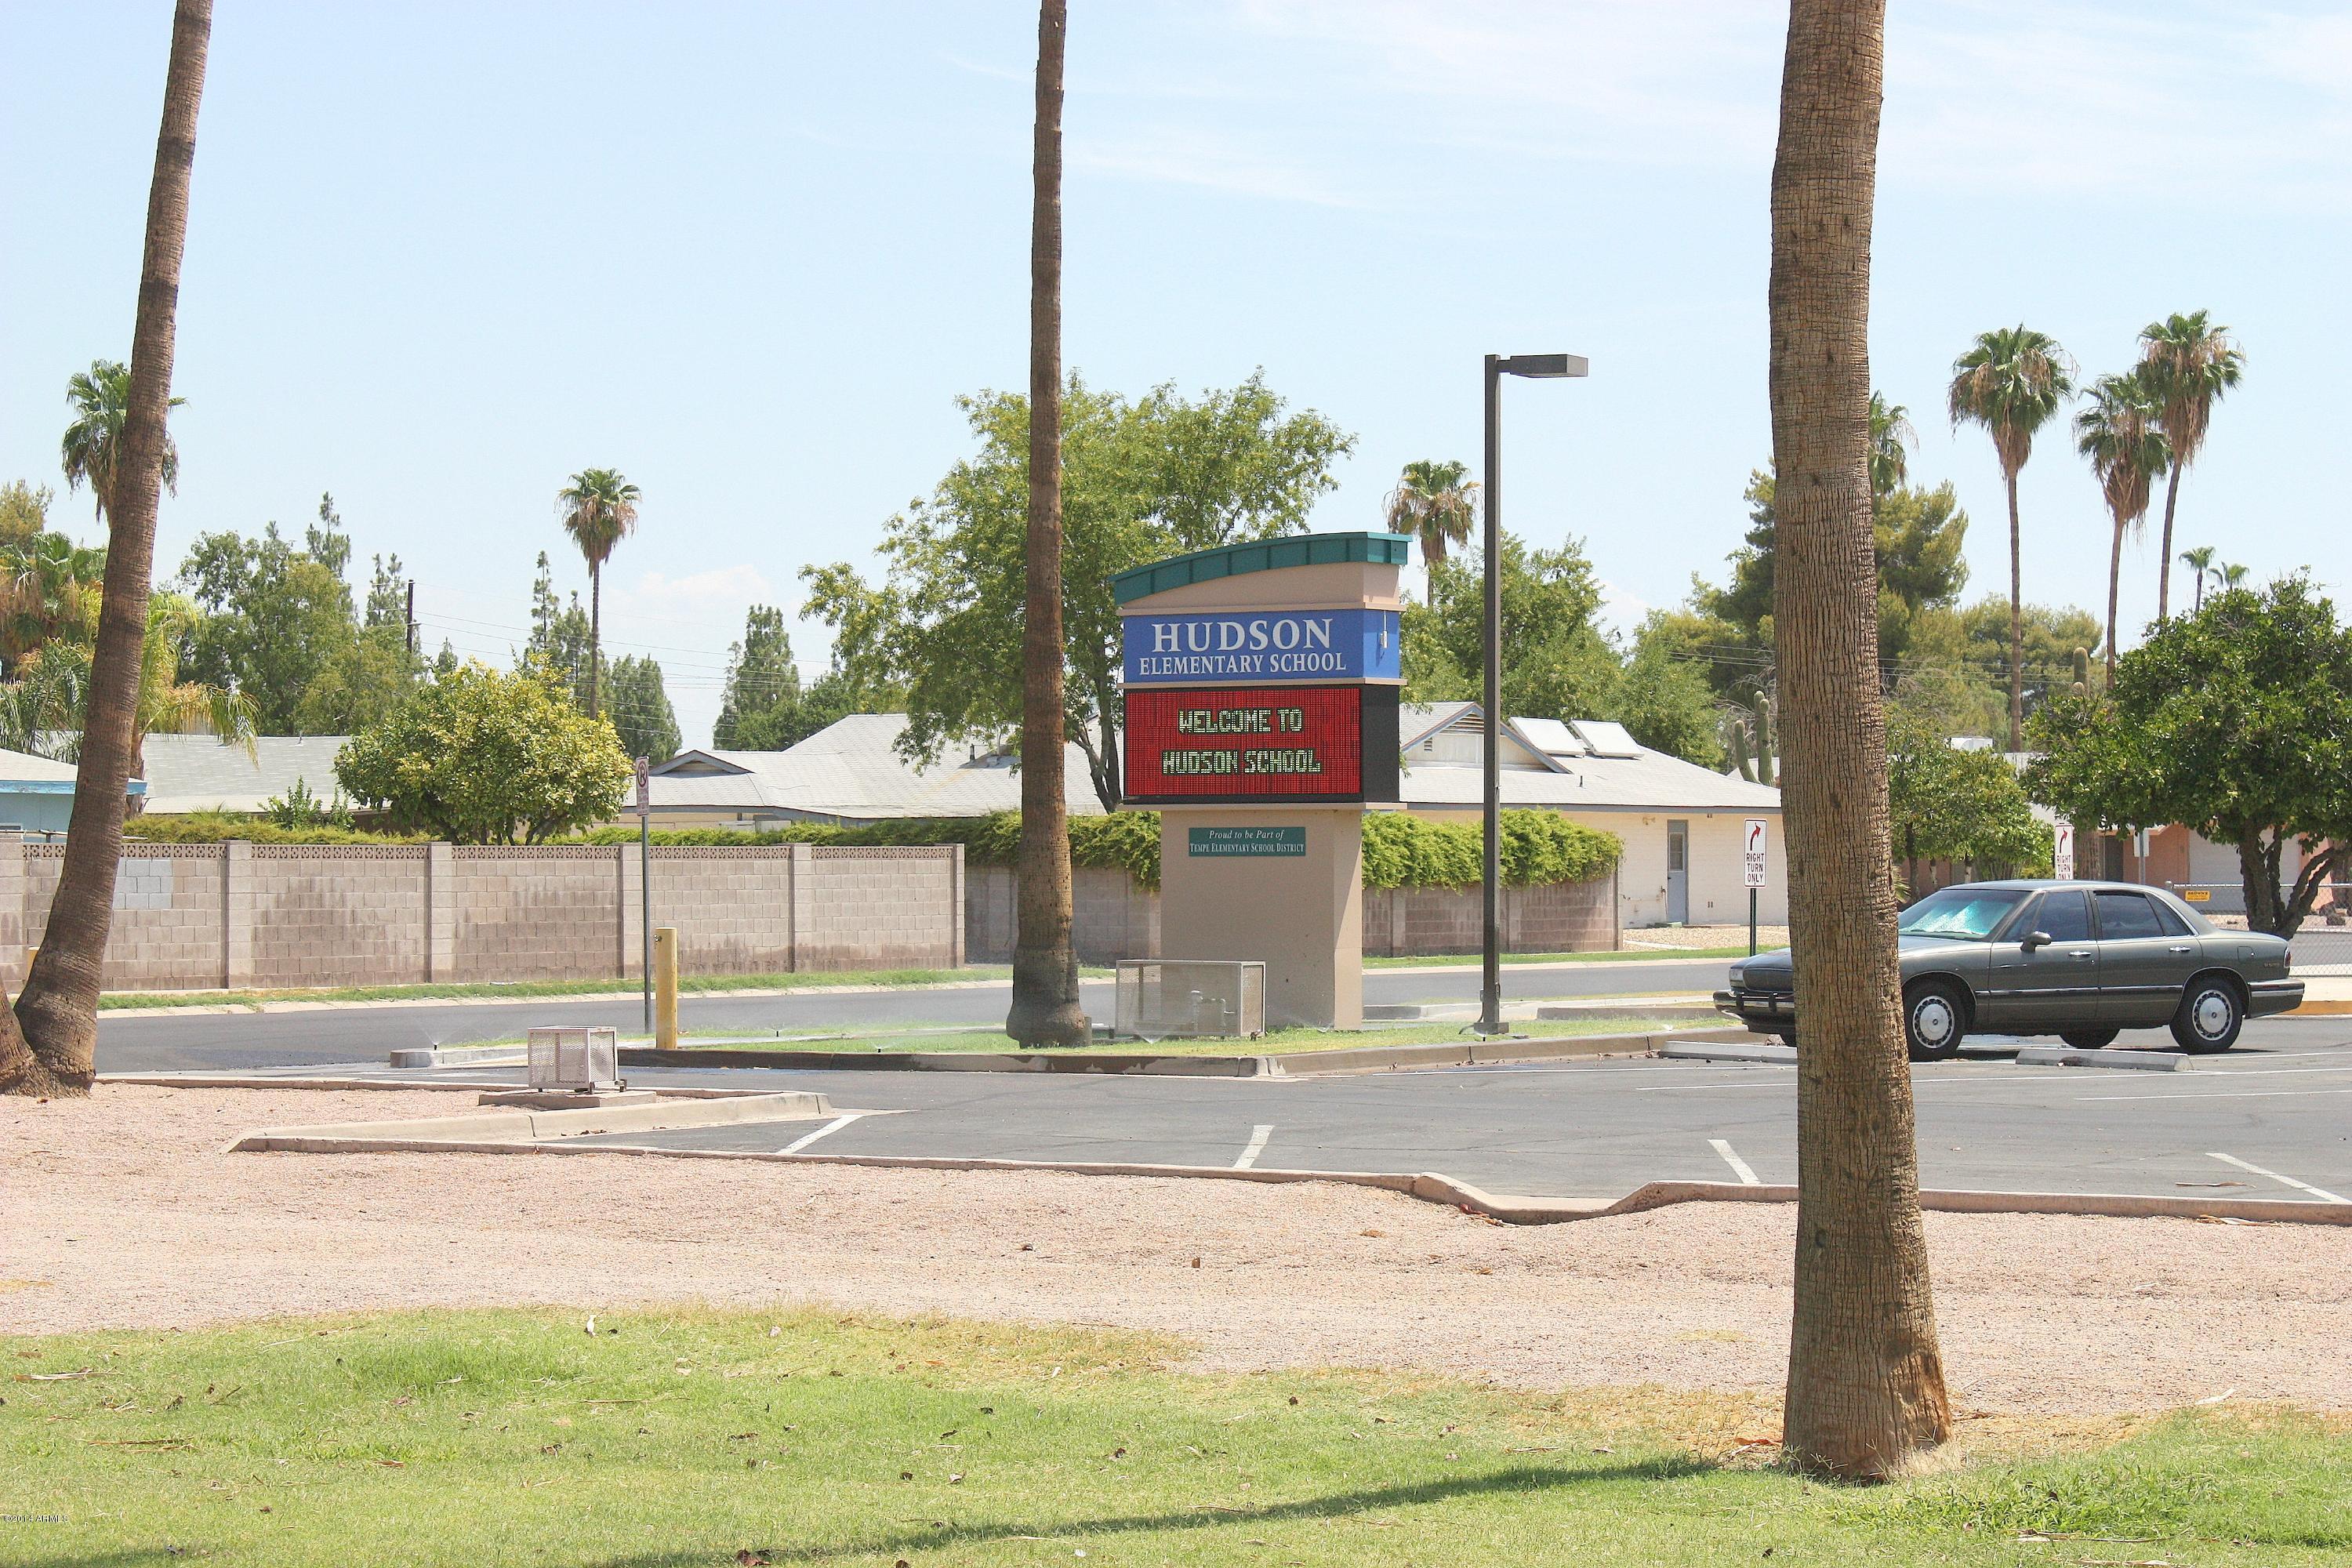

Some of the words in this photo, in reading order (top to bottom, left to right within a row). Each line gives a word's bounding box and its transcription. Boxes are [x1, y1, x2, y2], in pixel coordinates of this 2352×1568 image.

[1152, 619, 1333, 652] HUDSON
[1139, 655, 1264, 675] ELEMENTARY
[1269, 652, 1346, 673] SCHOOL
[1179, 710, 1271, 733] WELCOME
[1277, 709, 1302, 731] TO
[1163, 751, 1238, 774] HUDSON
[1243, 750, 1321, 773] SCHOOL
[1209, 830, 1232, 839] Proud
[1244, 830, 1253, 839] be
[1256, 830, 1274, 839] Part
[1275, 829, 1284, 840] of
[1190, 843, 1209, 852] TEMPE
[1211, 843, 1250, 852] ELEMENTARY
[1250, 843, 1275, 852] SCHOOL
[1276, 843, 1304, 852] DISTRICT
[1746, 853, 1764, 862] RIGHT
[2056, 855, 2071, 863] RIGHT
[1747, 863, 1763, 873] TURN
[2057, 864, 2071, 873] TURN
[1747, 873, 1763, 882] ONLY
